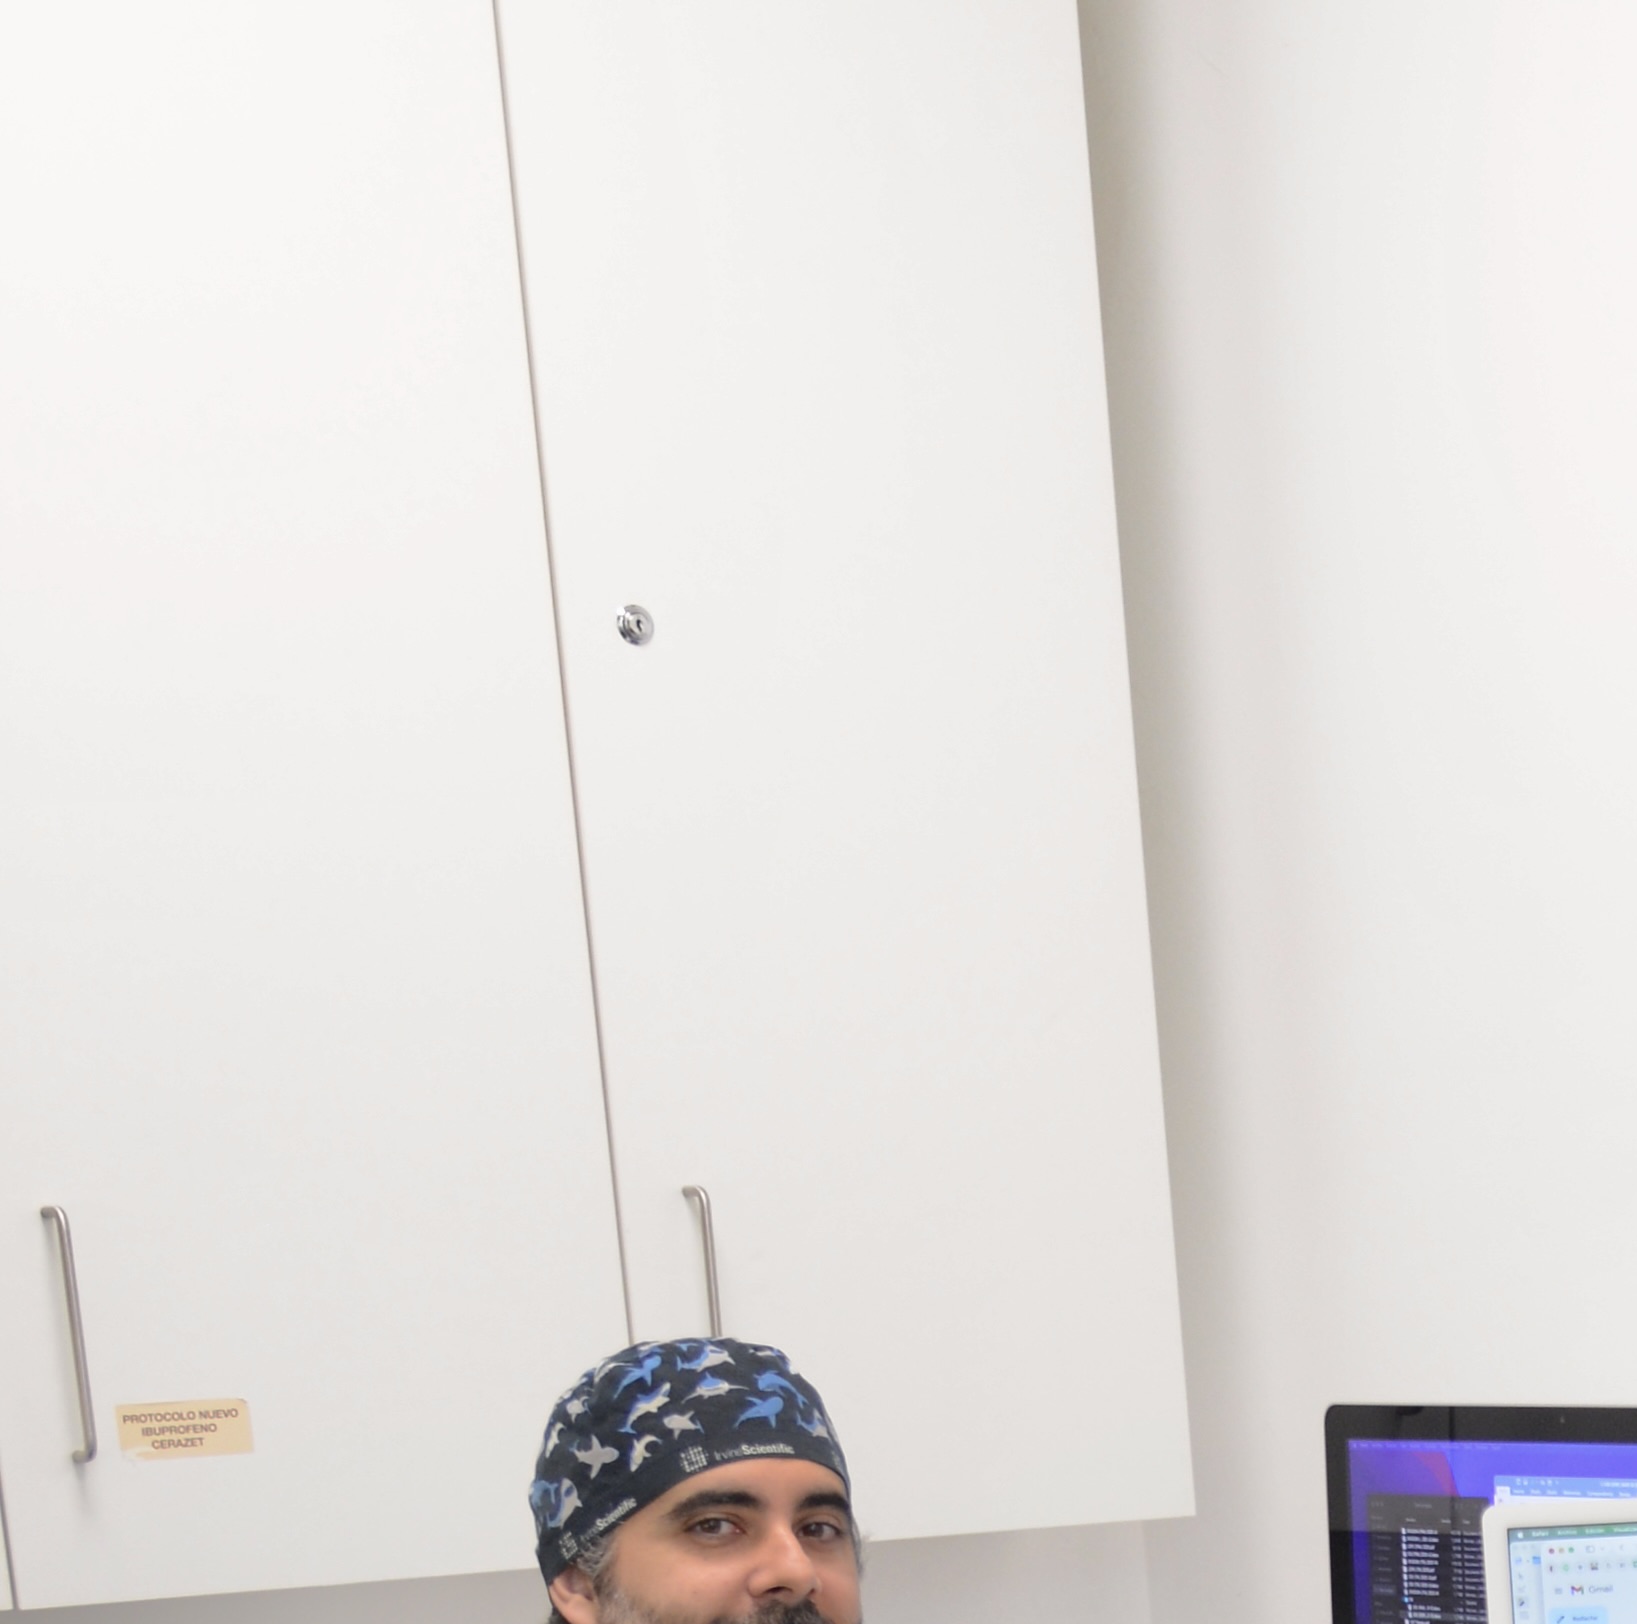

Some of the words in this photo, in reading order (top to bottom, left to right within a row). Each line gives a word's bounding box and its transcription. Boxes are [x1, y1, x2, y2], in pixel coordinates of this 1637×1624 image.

[123, 1411, 197, 1424] PROTOCOLO
[198, 1408, 239, 1420] NUEVO
[141, 1424, 217, 1436] IBUPROFENO
[151, 1437, 205, 1450] CERAZET
[1589, 1584, 1614, 1594] Gmail
